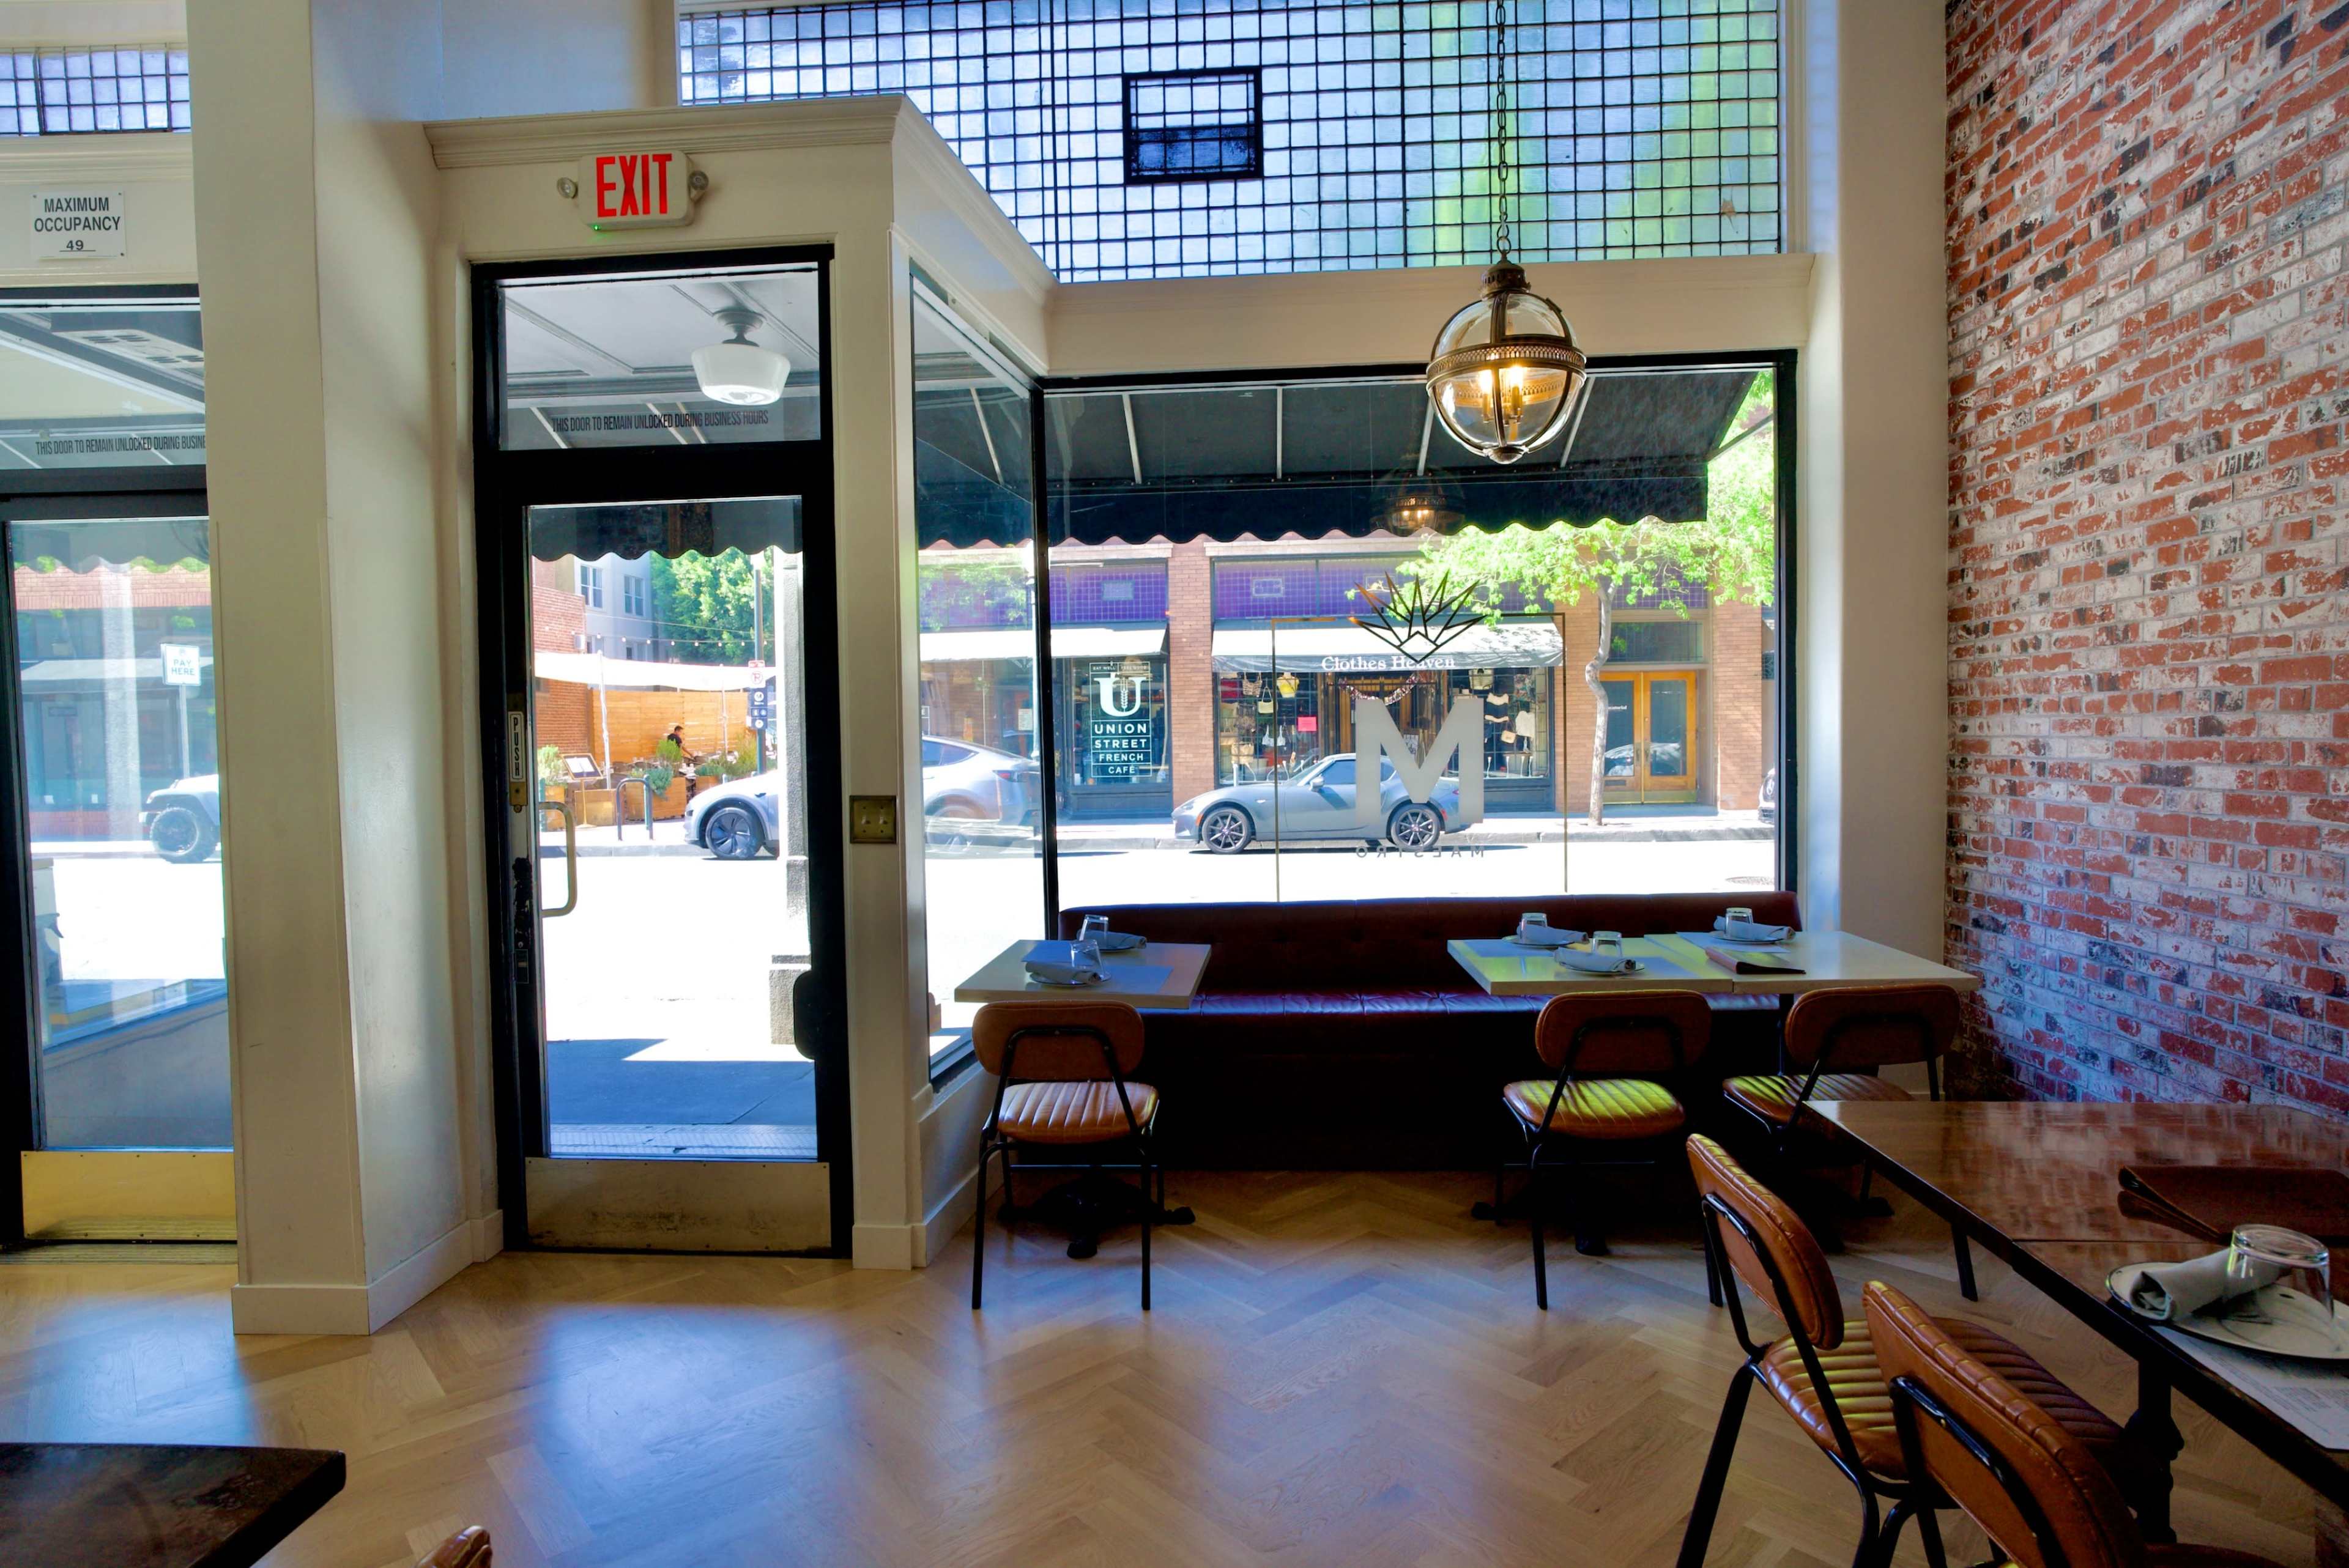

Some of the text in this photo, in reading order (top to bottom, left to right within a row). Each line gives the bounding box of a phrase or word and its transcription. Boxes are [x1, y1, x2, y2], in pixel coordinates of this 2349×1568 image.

[596, 153, 672, 218] EXIT
[44, 197, 109, 213] MAXIMUM
[34, 216, 121, 232] OCCUPANCY
[66, 240, 84, 250] 49
[552, 410, 768, 432] THIS DOOR TO REMAIN UNLOCKED DURING BUSINESS HOURS
[35, 440, 53, 455] THIS
[54, 439, 73, 454] DOOR
[75, 438, 84, 453] TO
[86, 437, 114, 453] REMAIN
[115, 436, 152, 451] UNLOCKED
[154, 435, 180, 450] DURING
[1321, 655, 1456, 670] Clothes Heaven
[171, 667, 195, 676] HERE
[1094, 723, 1147, 734] UNION
[1094, 739, 1147, 749] STREET
[1099, 753, 1143, 762] FRENCH
[1356, 698, 1484, 824] M
